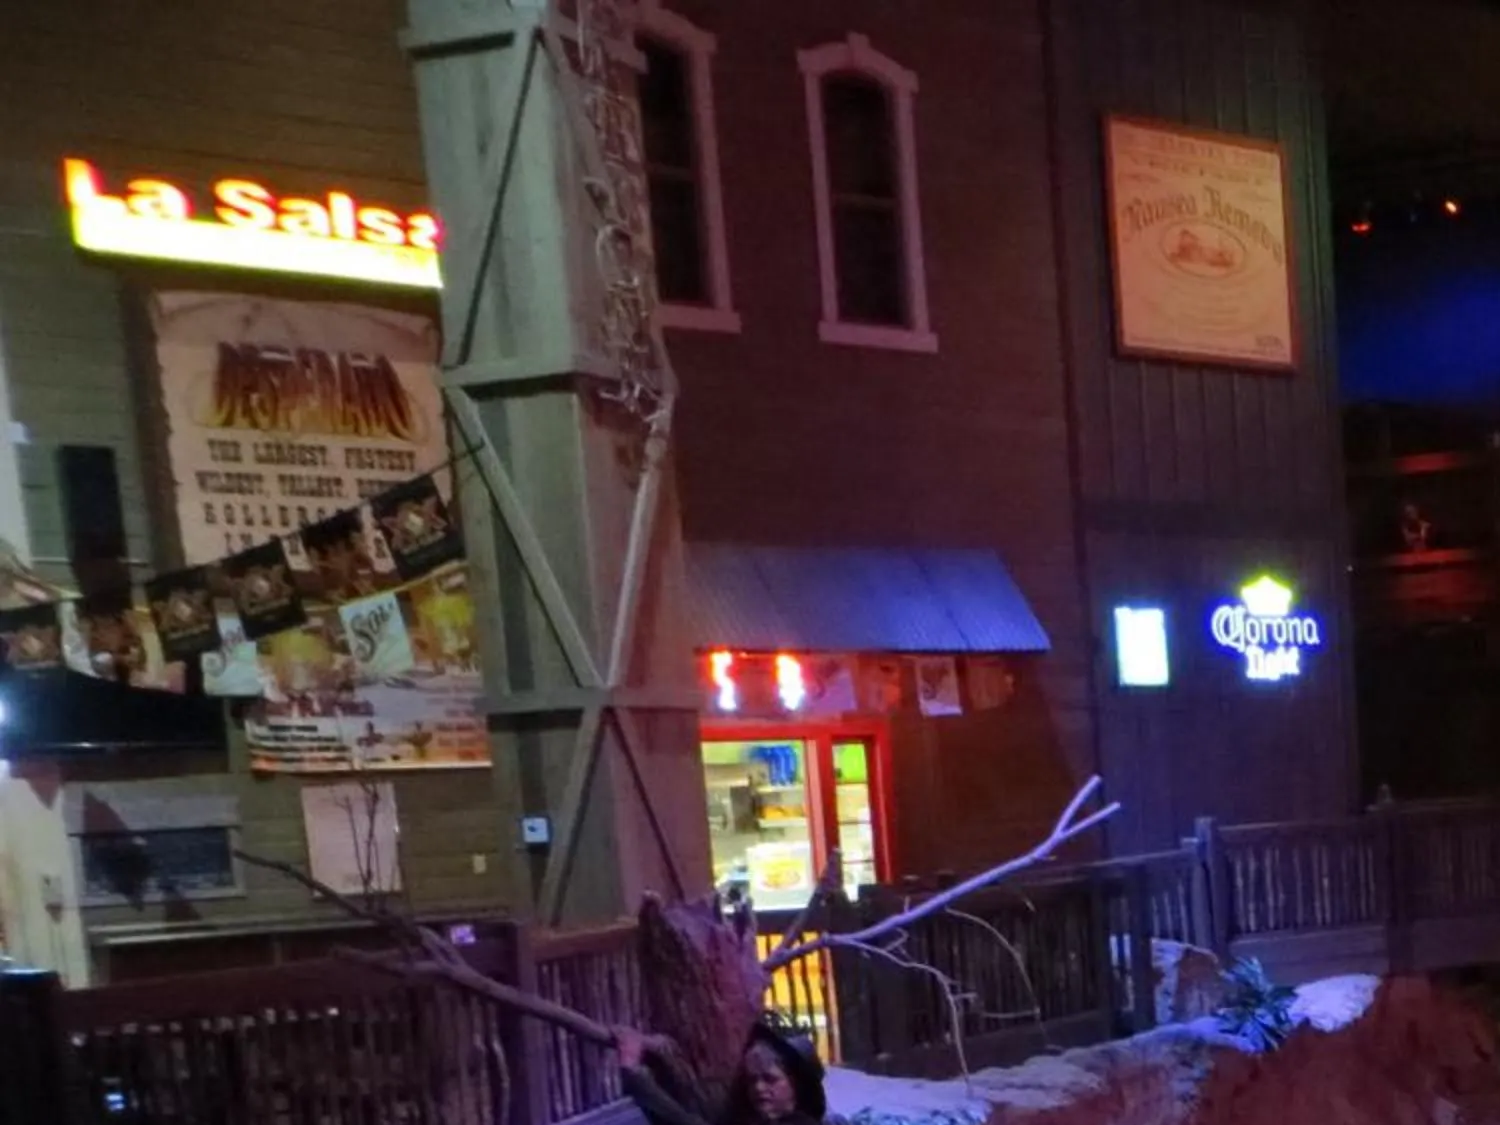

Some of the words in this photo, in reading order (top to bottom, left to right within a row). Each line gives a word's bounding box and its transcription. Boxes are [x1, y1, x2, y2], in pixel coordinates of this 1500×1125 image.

[64, 157, 194, 222] La
[212, 177, 442, 250] Salsa
[207, 438, 242, 462] THE
[1211, 605, 1320, 653] Corona
